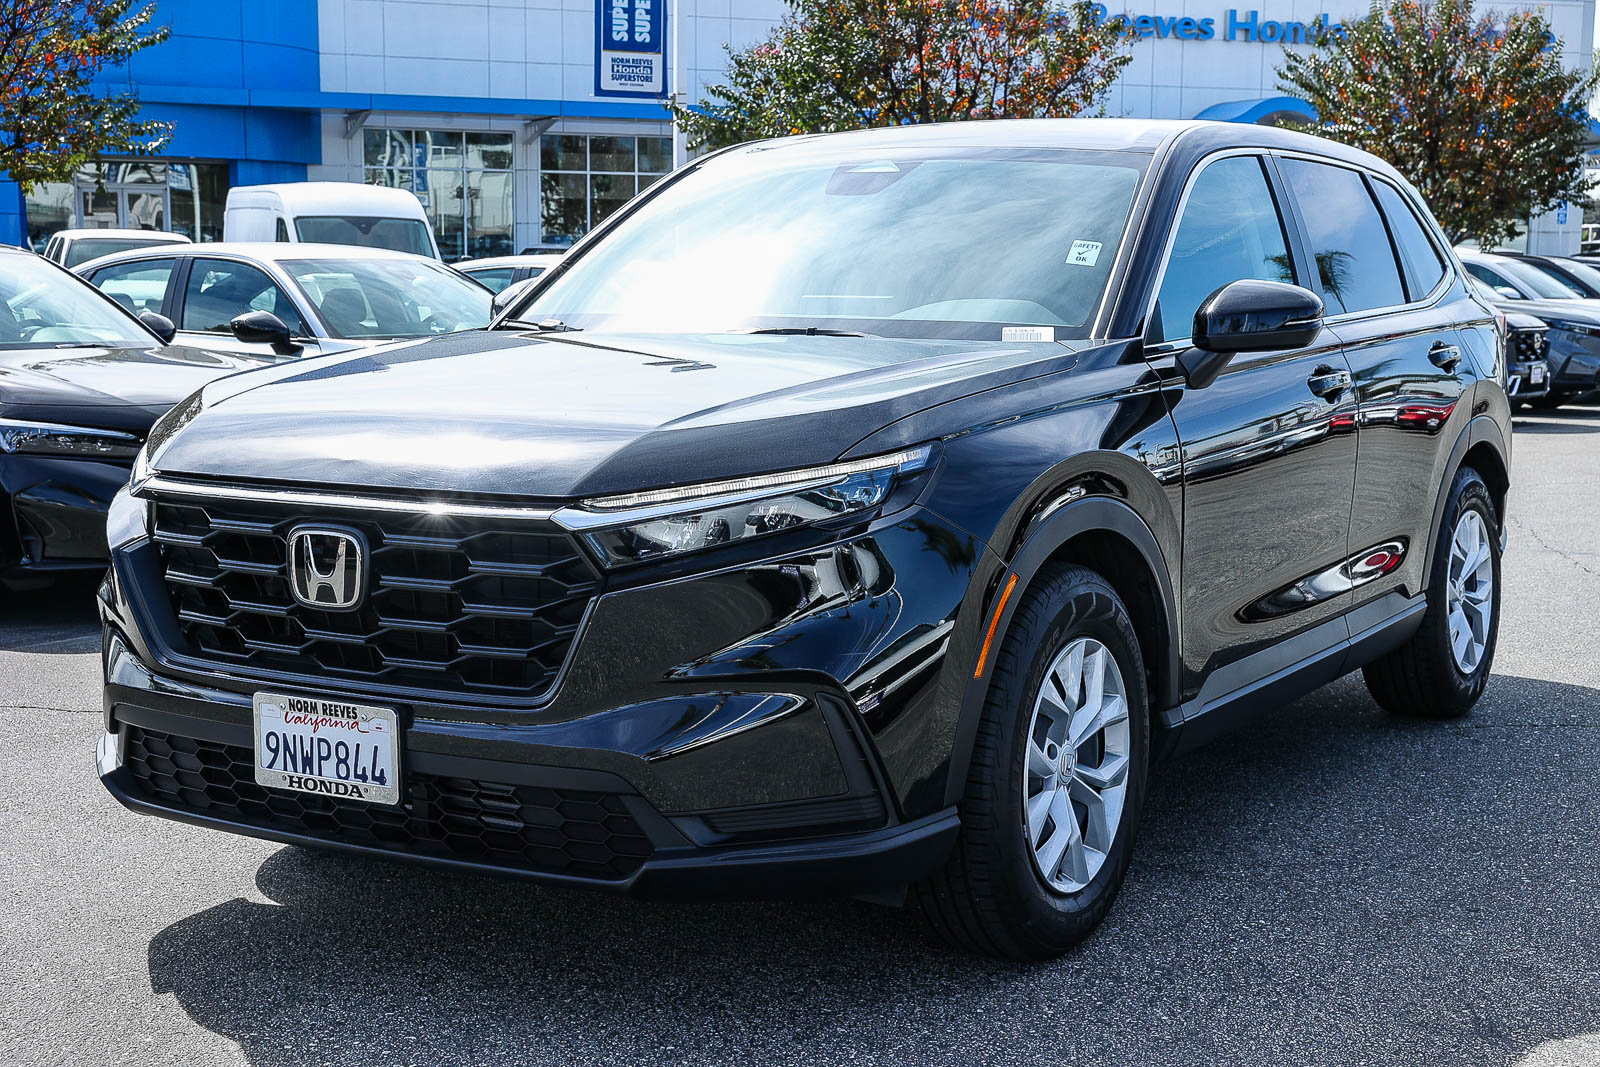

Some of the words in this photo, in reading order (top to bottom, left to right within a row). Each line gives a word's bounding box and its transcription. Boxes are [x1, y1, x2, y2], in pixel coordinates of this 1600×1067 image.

[611, 73, 653, 83] SUPERSTORE
[613, 64, 651, 75] Honda
[288, 698, 319, 715] NORM
[322, 703, 358, 720] REEVES
[284, 711, 369, 734] California
[265, 730, 387, 786] 9NWP844
[287, 774, 366, 800] HONDA
